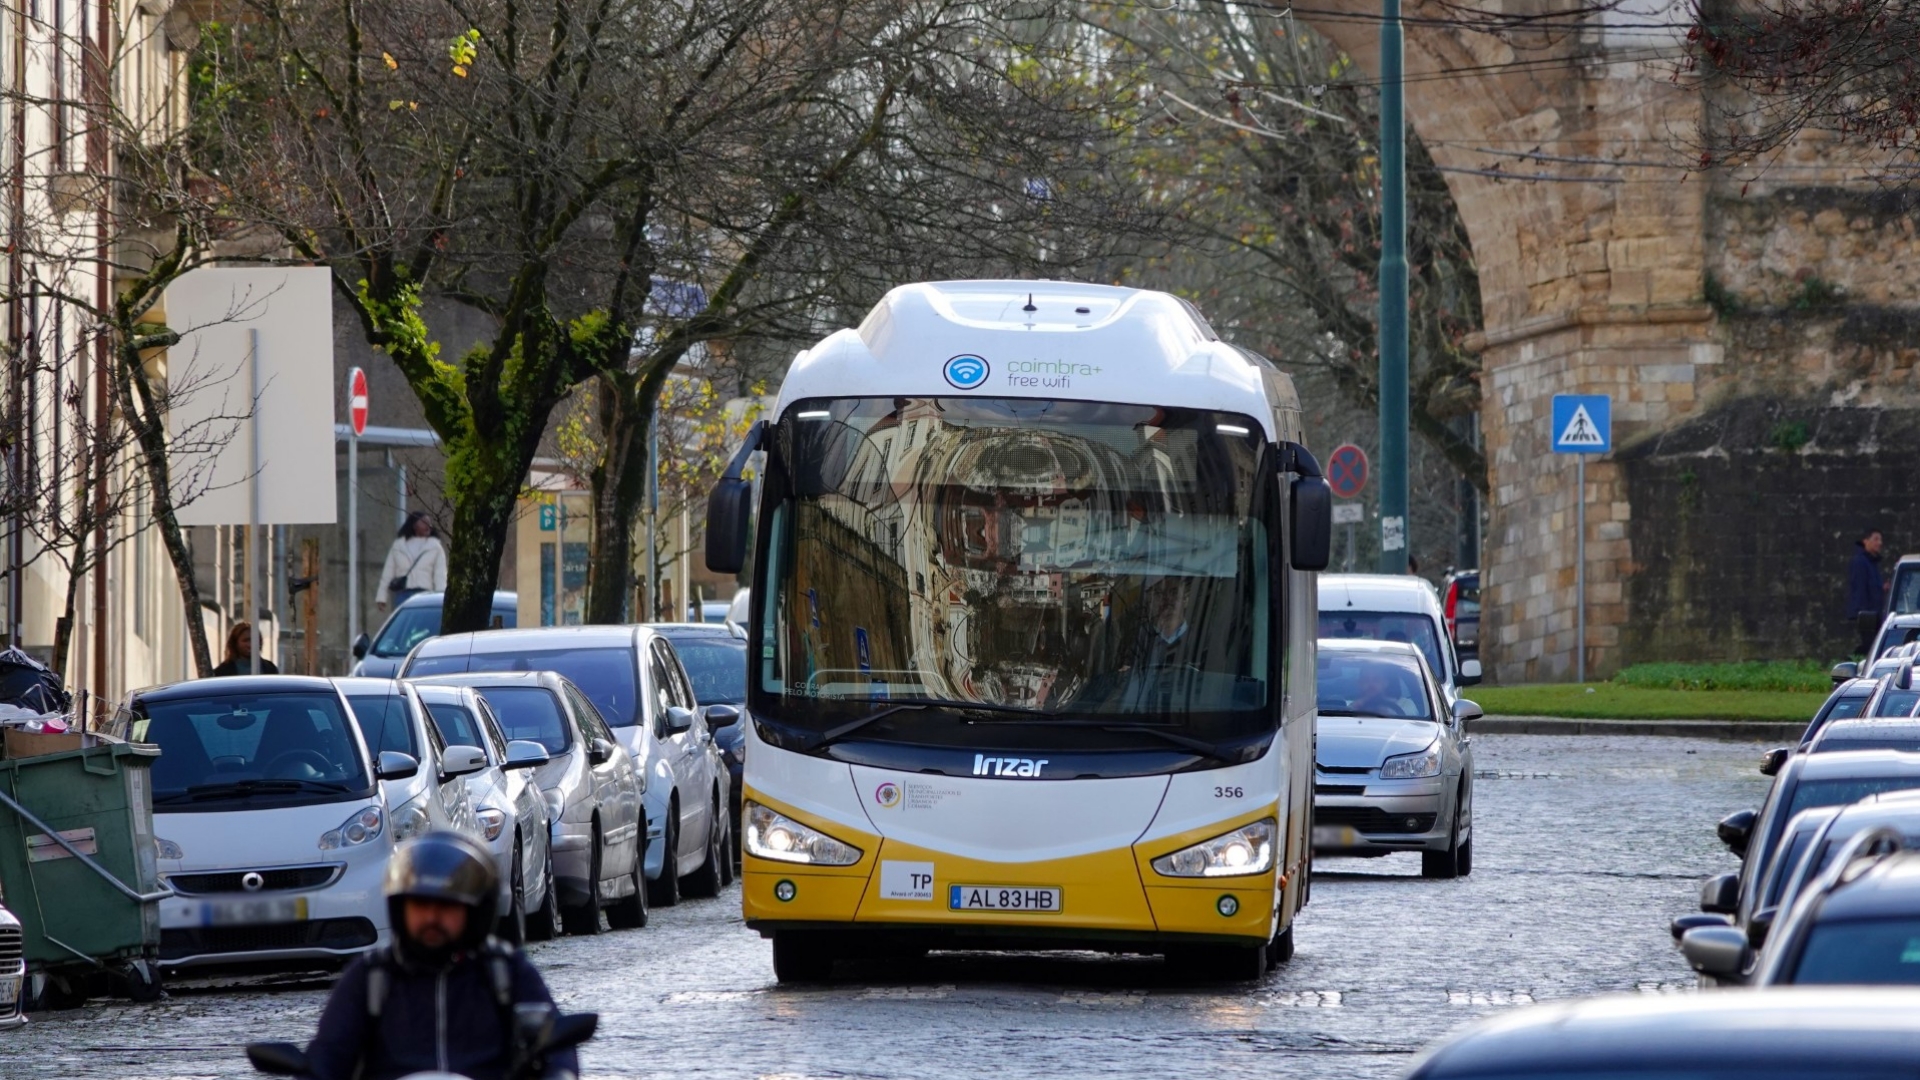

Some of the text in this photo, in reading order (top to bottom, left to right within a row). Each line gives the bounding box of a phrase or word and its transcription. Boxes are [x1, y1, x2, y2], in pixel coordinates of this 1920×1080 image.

[1007, 358, 1103, 376] coimbra+
[1007, 373, 1070, 389] free wifi
[973, 754, 1049, 777] Irizar
[1214, 786, 1244, 798] 356
[910, 873, 932, 890] TP
